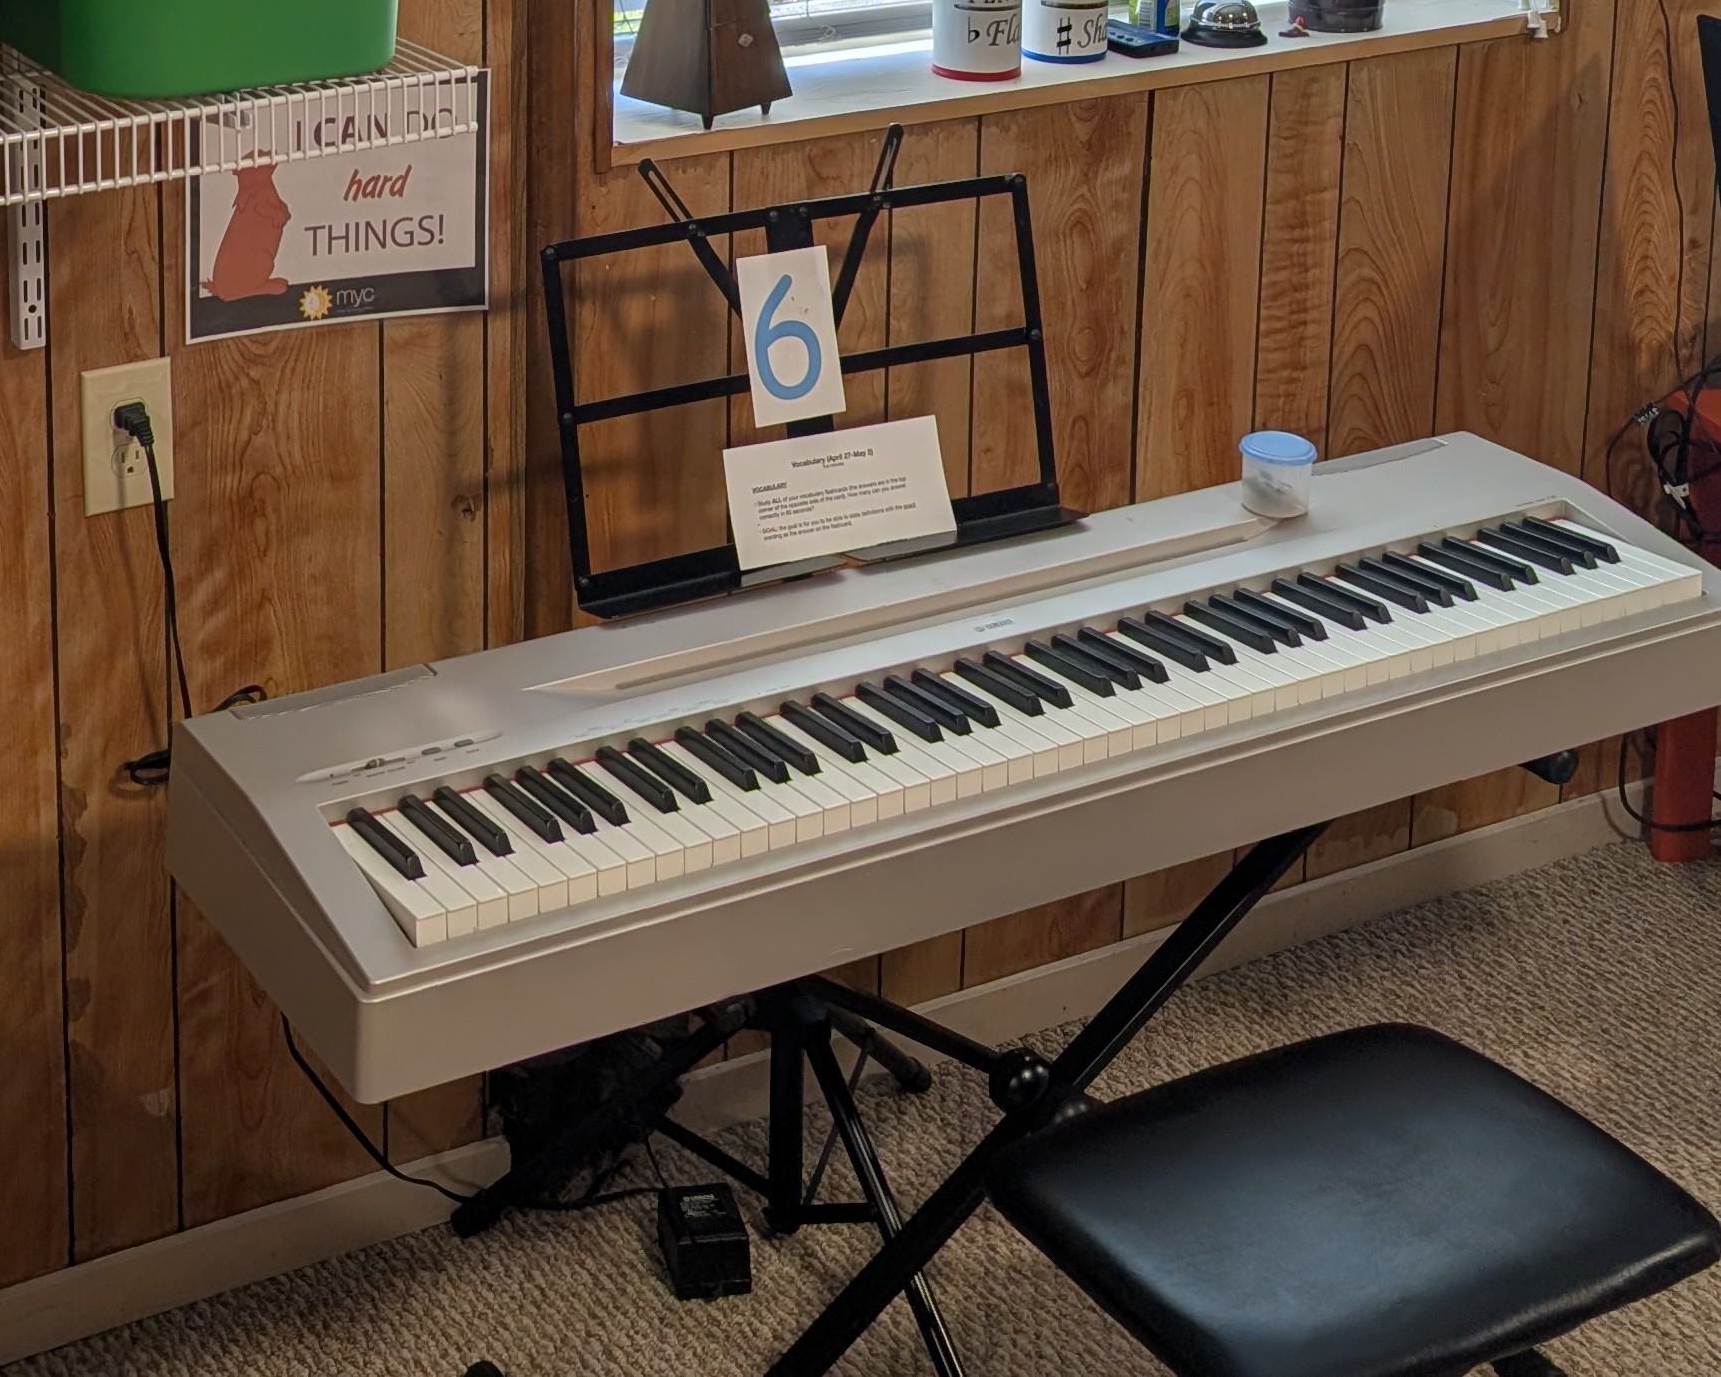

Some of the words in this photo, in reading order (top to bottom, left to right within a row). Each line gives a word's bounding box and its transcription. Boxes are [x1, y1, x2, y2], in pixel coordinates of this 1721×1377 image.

[297, 121, 302, 152] I
[314, 112, 391, 148] CAN
[406, 108, 457, 139] DO
[343, 164, 412, 202] hard
[304, 214, 445, 257] THINGS!
[336, 287, 375, 308] myc
[755, 274, 821, 400] 6
[791, 457, 825, 468] Vocabulary
